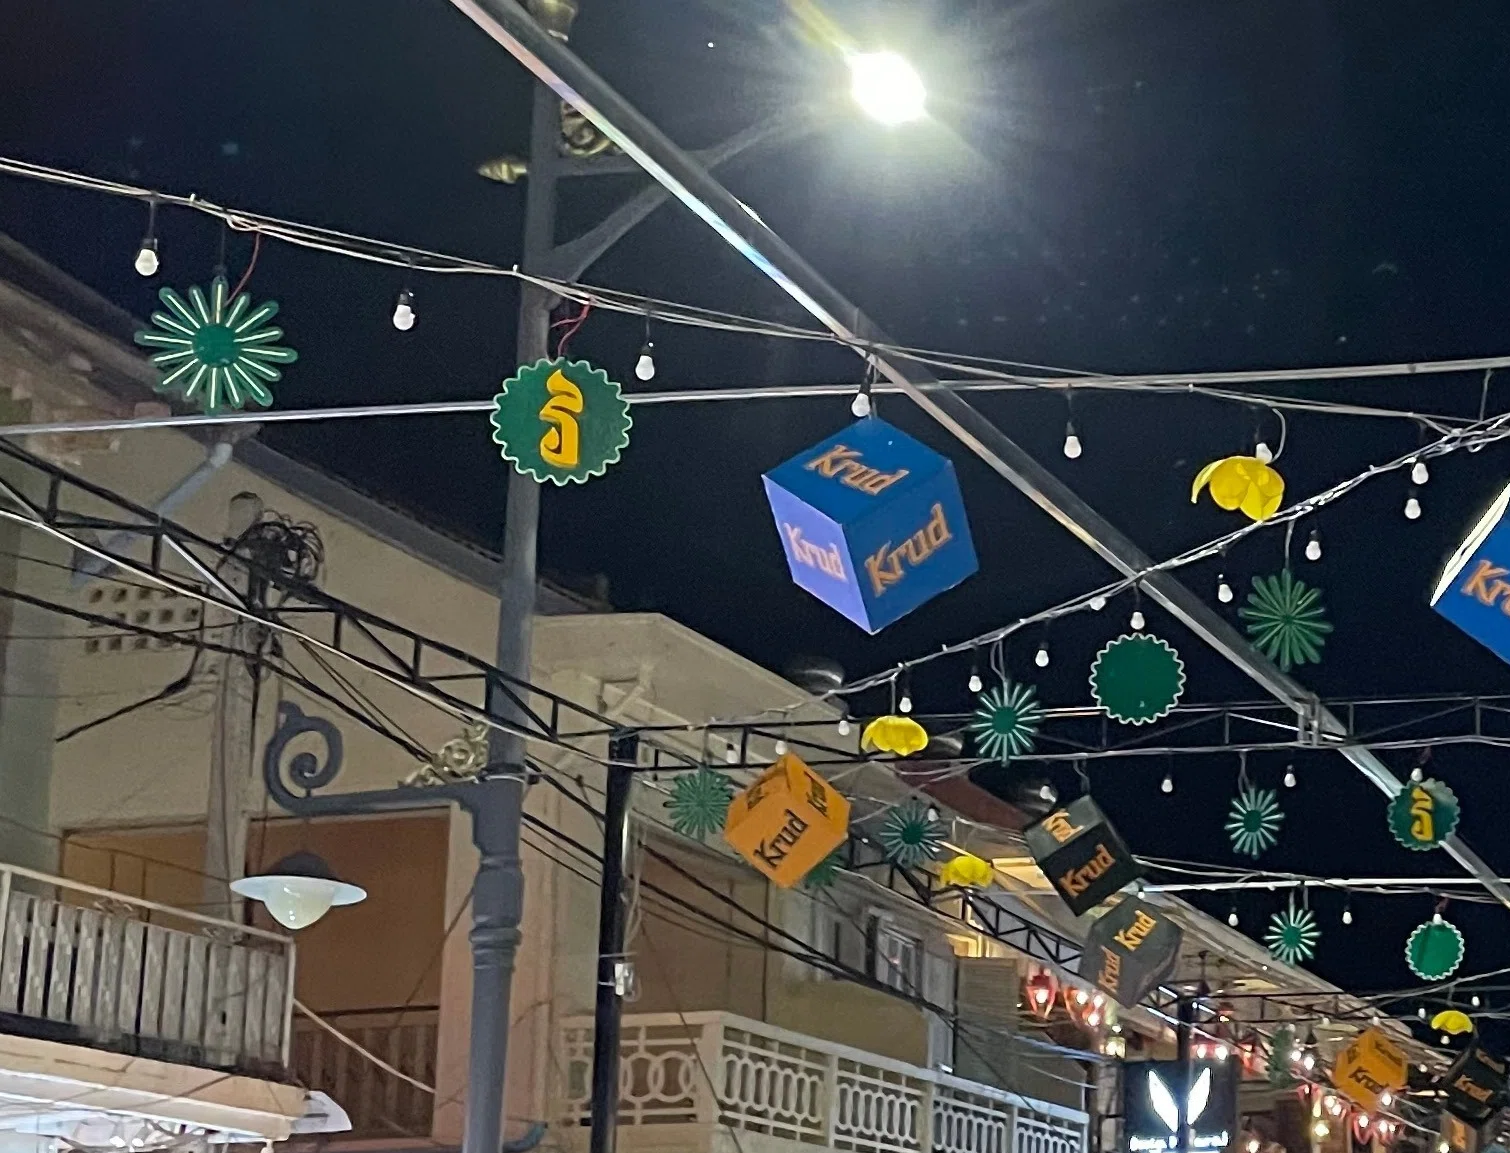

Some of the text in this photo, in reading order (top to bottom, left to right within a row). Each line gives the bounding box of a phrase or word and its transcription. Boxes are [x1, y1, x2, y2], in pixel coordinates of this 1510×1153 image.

[805, 444, 910, 495] Krud
[784, 522, 849, 581] Krud
[864, 503, 953, 598] Krud
[753, 808, 809, 870] Krud
[1059, 843, 1117, 899] Krud
[1114, 909, 1157, 952] Krud
[1098, 944, 1121, 995] Krud
